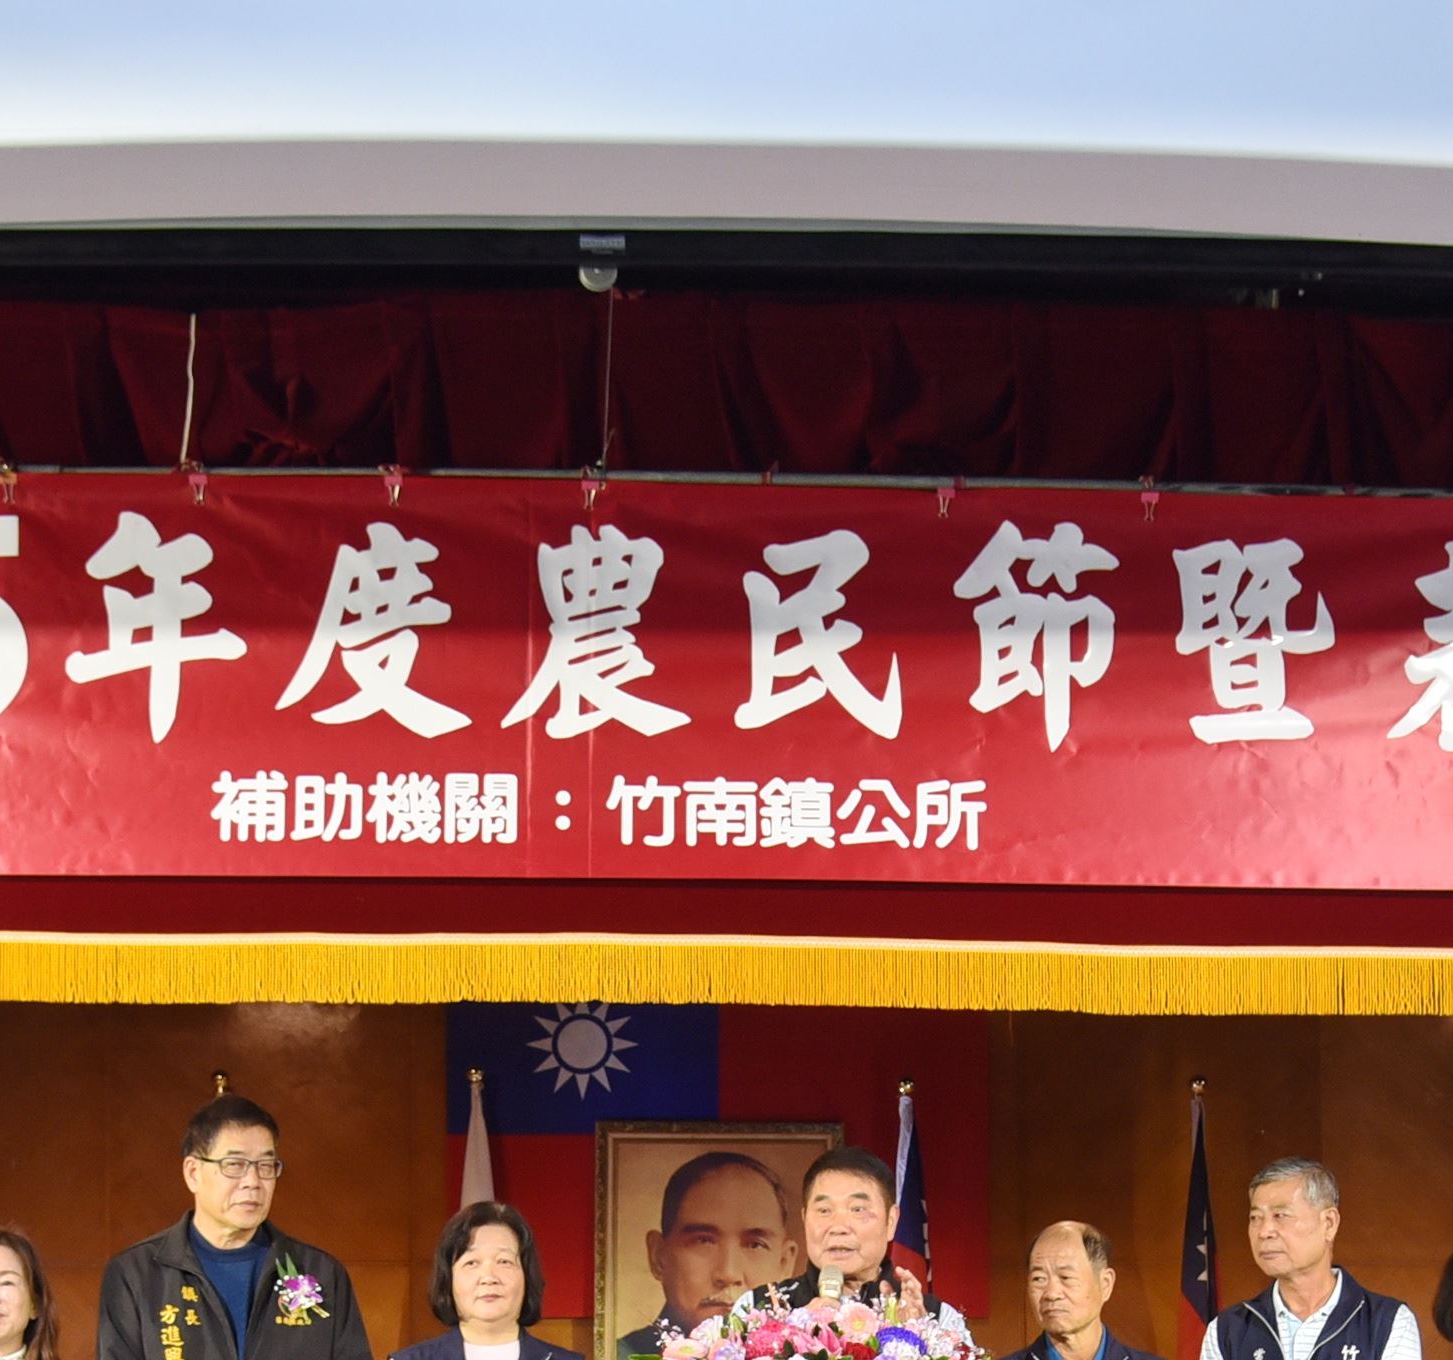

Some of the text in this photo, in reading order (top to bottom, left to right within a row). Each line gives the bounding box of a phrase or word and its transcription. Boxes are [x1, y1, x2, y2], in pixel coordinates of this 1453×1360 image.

[212, 772, 987, 851] 補助機關：竹南鎮公所
[180, 1285, 202, 1326] 鎮長
